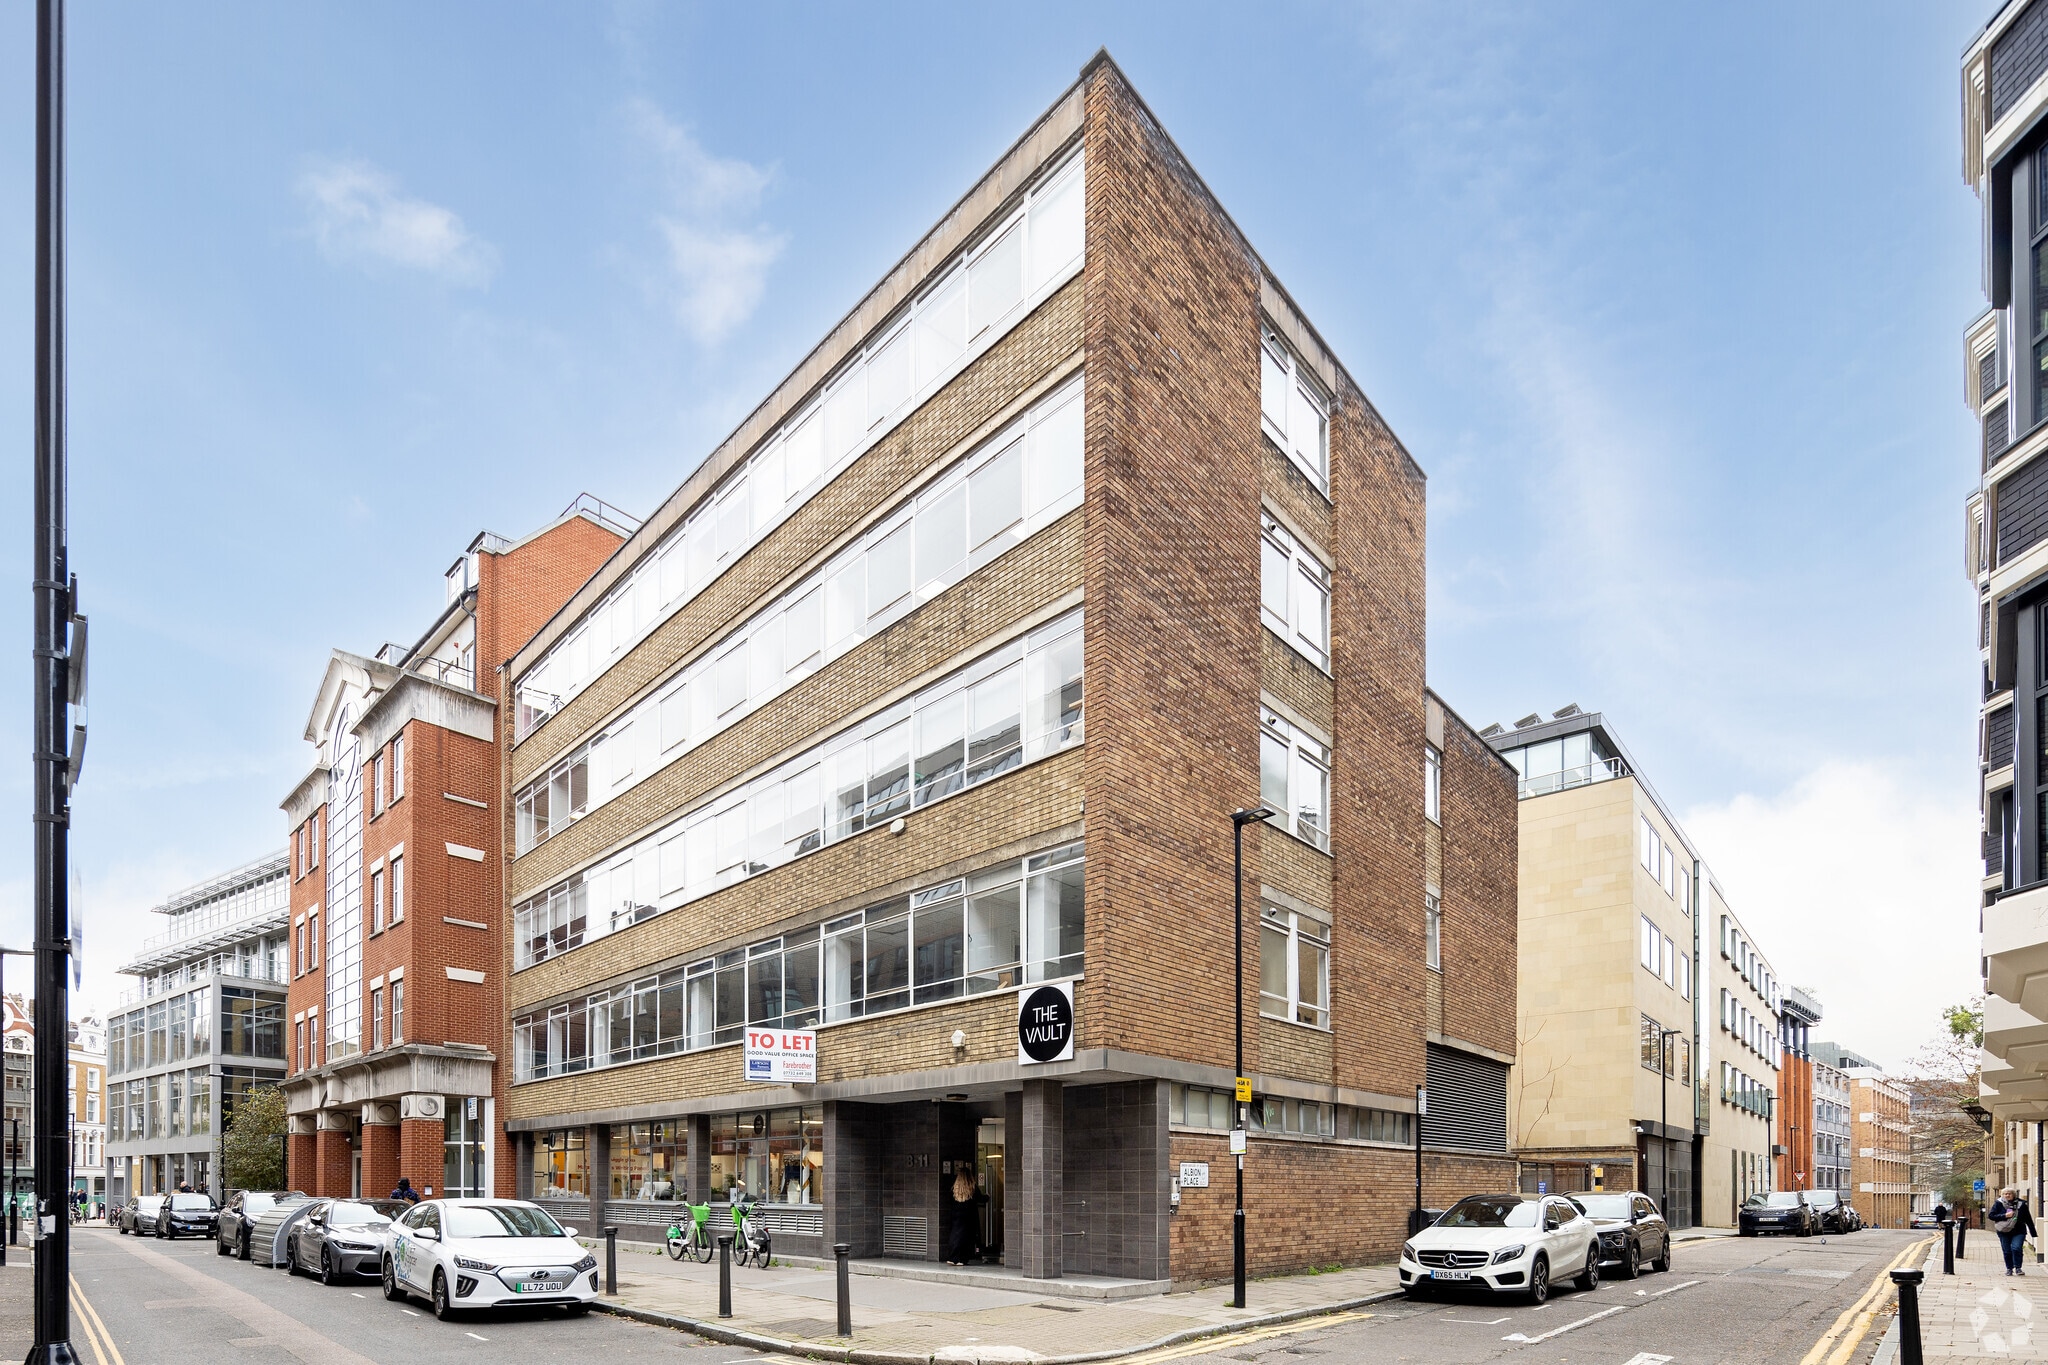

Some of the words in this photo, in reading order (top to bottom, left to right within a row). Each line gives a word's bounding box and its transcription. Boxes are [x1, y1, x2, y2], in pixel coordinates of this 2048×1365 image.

[1032, 1004, 1058, 1023] THE
[1025, 1023, 1066, 1044] VAULT
[748, 1033, 775, 1048] TO
[782, 1035, 812, 1050] LET
[782, 1061, 812, 1069] Farebrother
[1184, 1168, 1202, 1176] ALBION
[1184, 1177, 1199, 1186] PLACE
[522, 1283, 544, 1291] LL72
